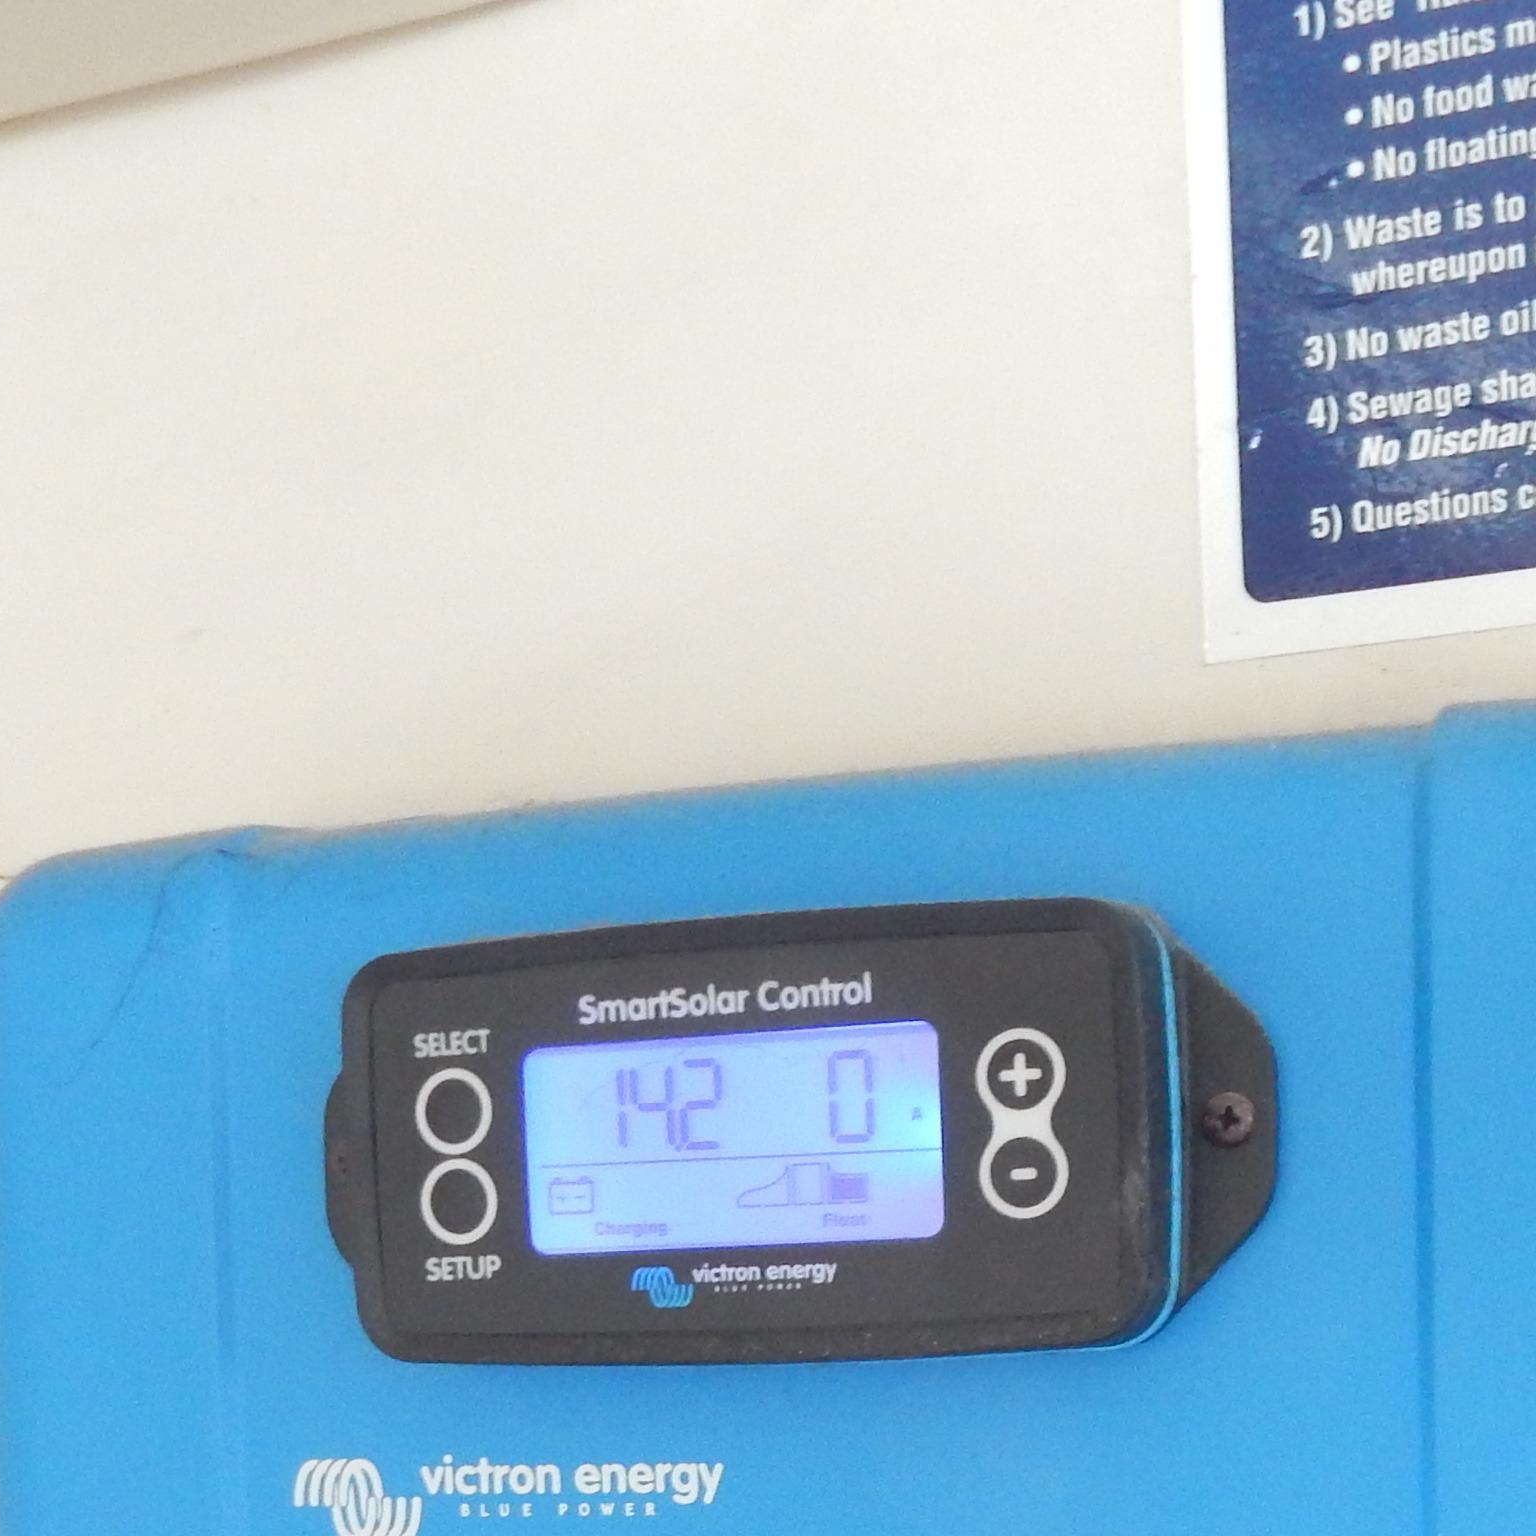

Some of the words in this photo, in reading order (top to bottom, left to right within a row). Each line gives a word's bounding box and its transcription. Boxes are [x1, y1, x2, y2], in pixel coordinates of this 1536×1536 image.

[1293, 4, 1326, 41] 1)
[1335, 0, 1395, 29] See
[1369, 26, 1496, 75] Plastics
[1371, 93, 1415, 128] No
[1422, 73, 1494, 118] food
[1372, 145, 1417, 182] No
[1298, 222, 1334, 263] 2)
[1343, 206, 1442, 250] Waste
[1454, 198, 1483, 231] is
[1493, 191, 1526, 224] to
[1350, 242, 1526, 296] whereupon
[1302, 332, 1338, 371] 3)
[1345, 326, 1389, 361] No
[1396, 310, 1491, 353] waste
[1306, 395, 1339, 434] 4)
[1347, 382, 1472, 425] Sewage
[1357, 434, 1401, 469] No
[1309, 504, 1343, 543] 5)
[1351, 484, 1509, 534] Questions
[578, 984, 750, 1025] SmartSolar
[757, 971, 873, 1012] Control
[413, 1028, 491, 1058] SELECT
[827, 1049, 876, 1144] 0
[425, 1254, 502, 1282] SETUP
[692, 1262, 761, 1283] victron
[765, 1263, 837, 1286] energy
[419, 1453, 562, 1496] victron
[573, 1462, 724, 1507] energy
[459, 1502, 532, 1518] BLUE
[558, 1502, 656, 1517] POWER
